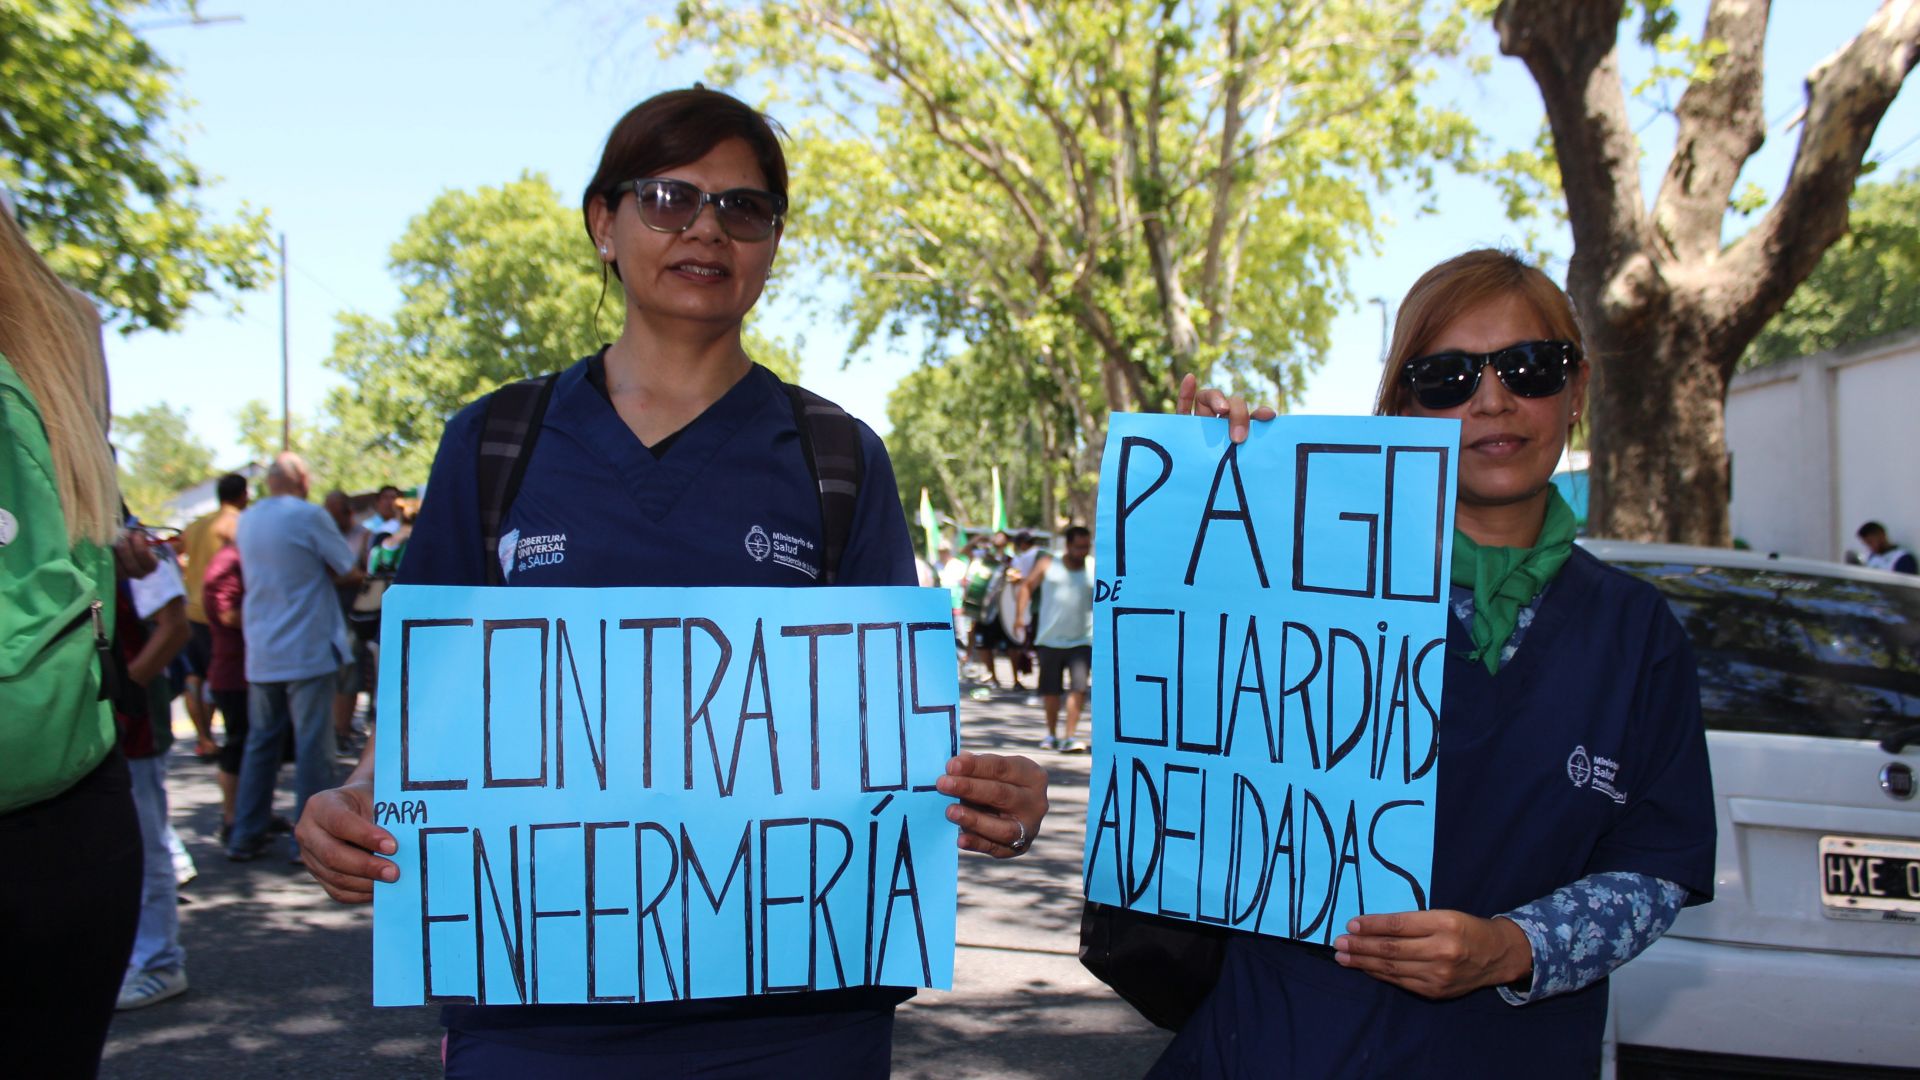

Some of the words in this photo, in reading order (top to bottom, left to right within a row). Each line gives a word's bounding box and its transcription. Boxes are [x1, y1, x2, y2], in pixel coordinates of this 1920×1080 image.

[1115, 436, 1449, 603] PAGO
[518, 533, 567, 549] COBERTURA
[518, 542, 565, 559] UNIVERSAL
[773, 541, 798, 555] Salud
[528, 552, 564, 568] SALUD
[1095, 579, 1121, 602] DE
[401, 617, 956, 797] CONTRATOS
[374, 800, 428, 825] PARA
[1827, 856, 1886, 895] HXE
[418, 794, 933, 1006] ENFERMERÍA
